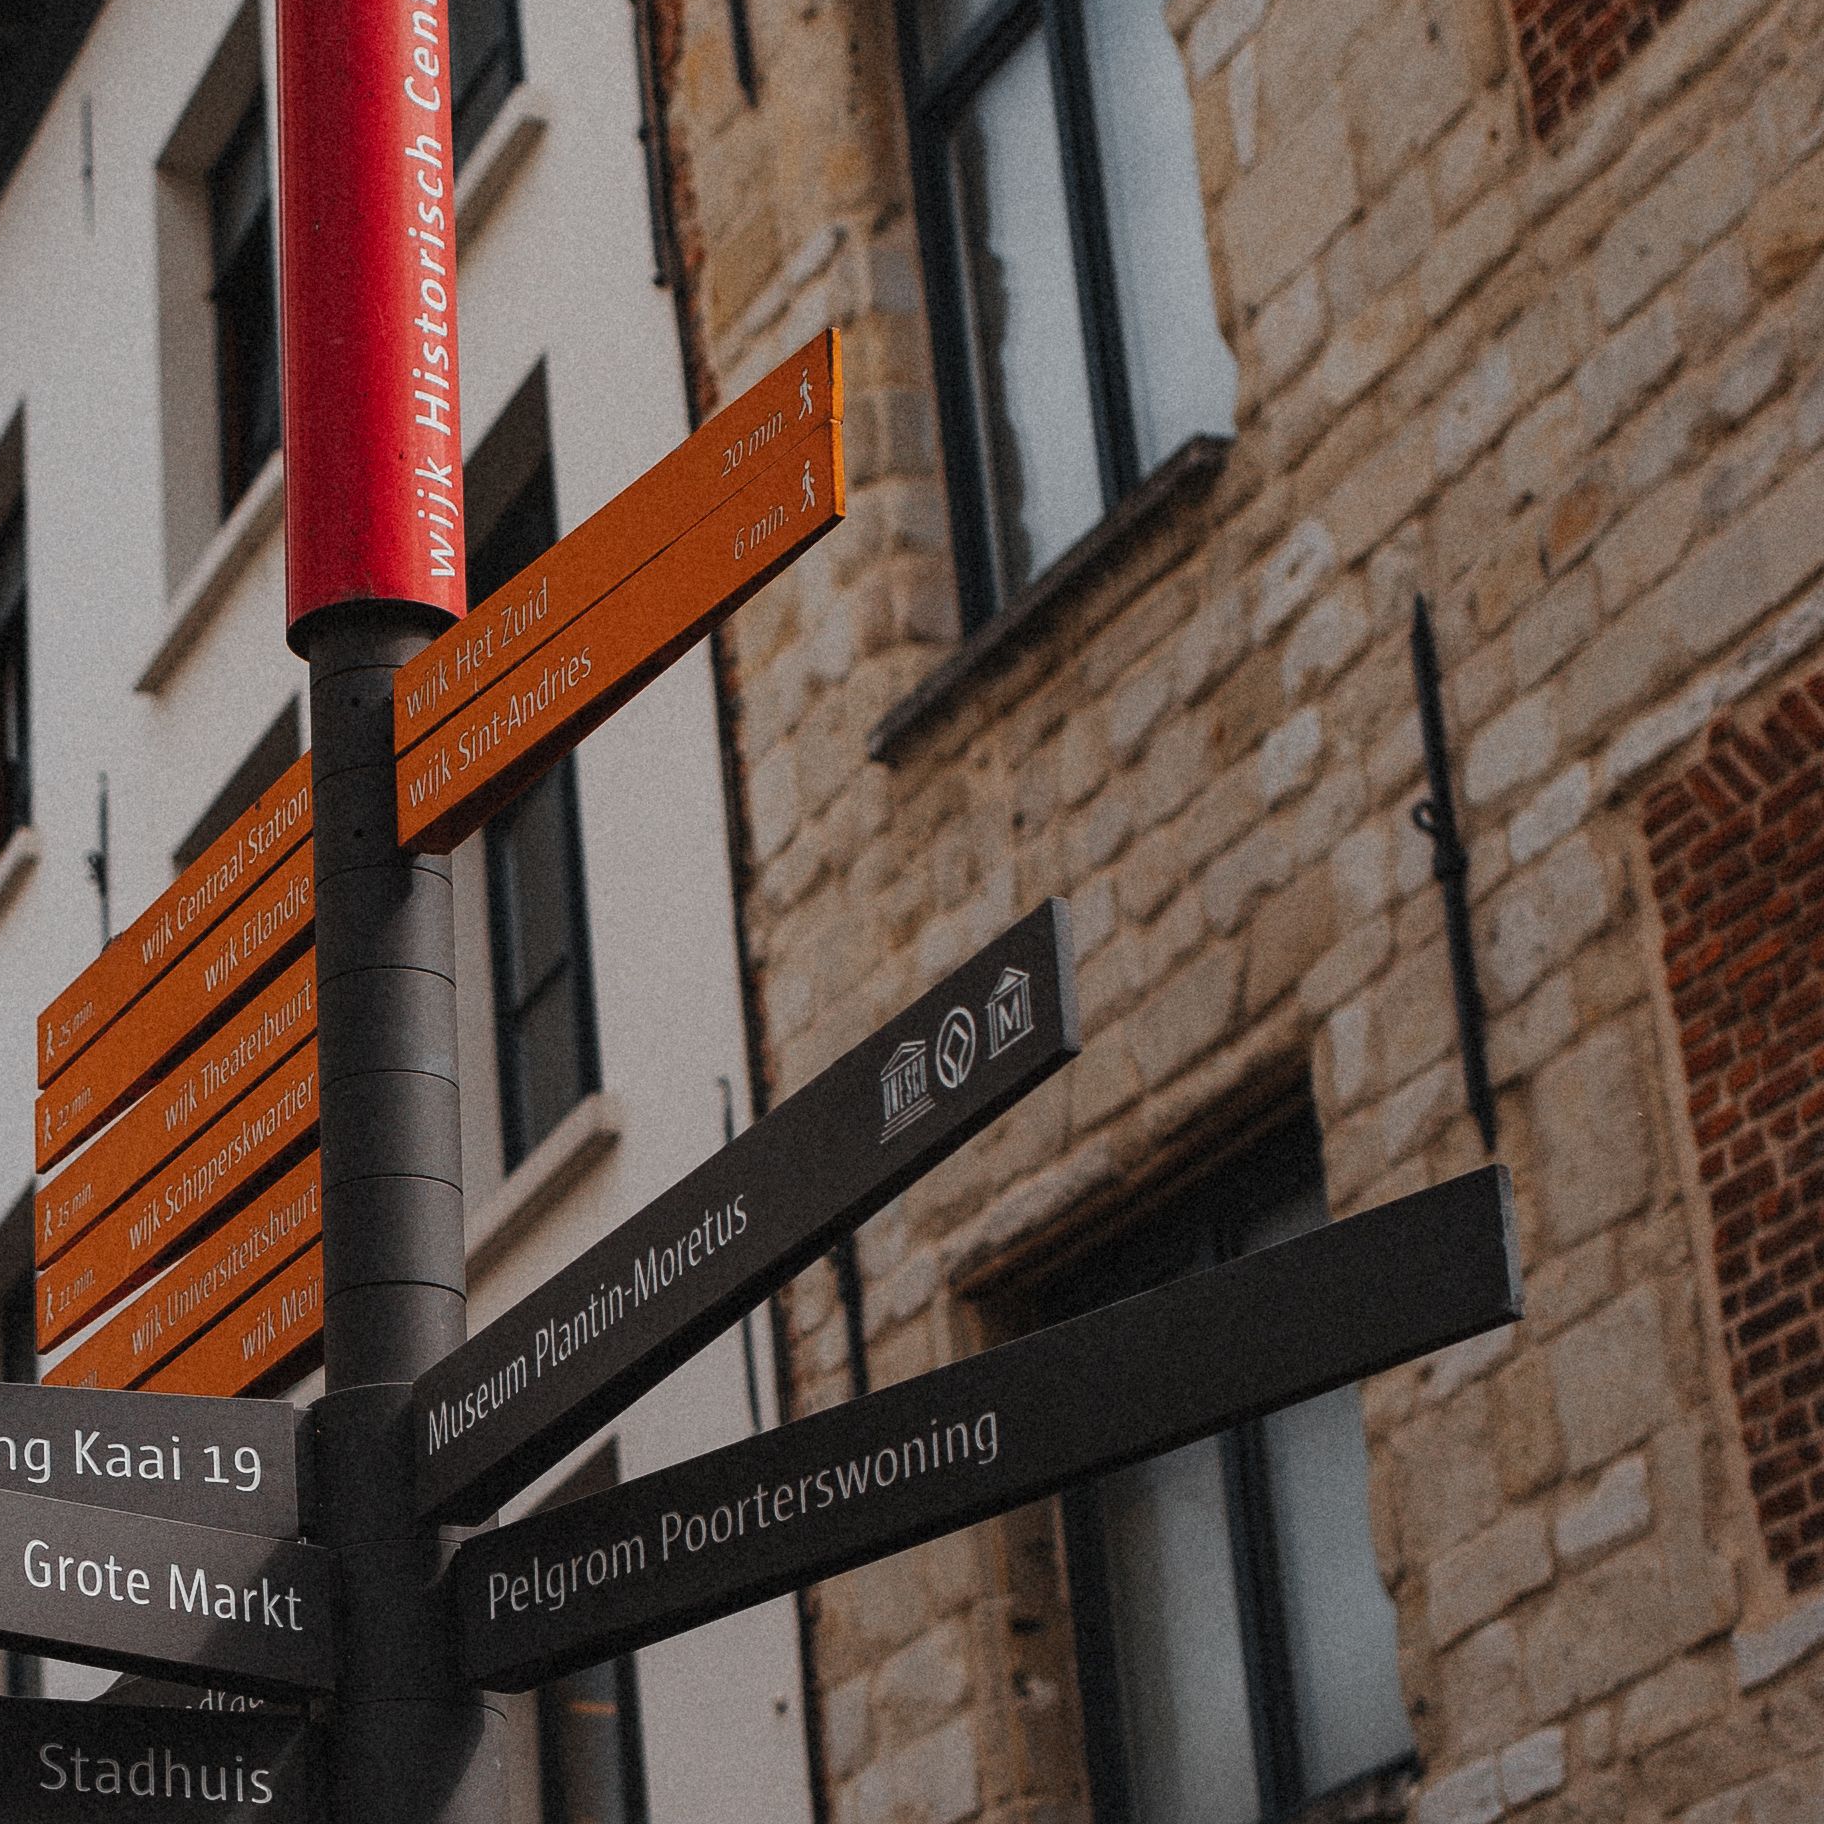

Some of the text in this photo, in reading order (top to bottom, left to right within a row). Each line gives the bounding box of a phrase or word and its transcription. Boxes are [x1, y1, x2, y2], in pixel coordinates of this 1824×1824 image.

[405, 134, 452, 436] Historisch
[721, 409, 789, 478] 20 min.
[414, 457, 459, 578] wijk
[733, 503, 789, 561] 6 min.
[406, 577, 549, 719] wijk Het Zuid
[408, 647, 593, 808] wijk Sint-Andries
[141, 785, 309, 965] wijk Centraal Station
[204, 876, 310, 992] wijk Eilandje
[164, 979, 313, 1132] wijk Theaterbuurt
[129, 1071, 316, 1251] wijk Schipperskwartier
[132, 1181, 318, 1356] wijk Universiteitsbuurt
[242, 1275, 319, 1361] wijk Meir
[428, 1193, 748, 1457] Museum Plantin-Moretus
[74, 1429, 182, 1481] Kaai
[203, 1444, 263, 1492] 19
[487, 1410, 1001, 1621] Pelgrom Poorterswoning
[23, 1538, 304, 1632] Grote Markt
[38, 1743, 274, 1804] Stadhuis
